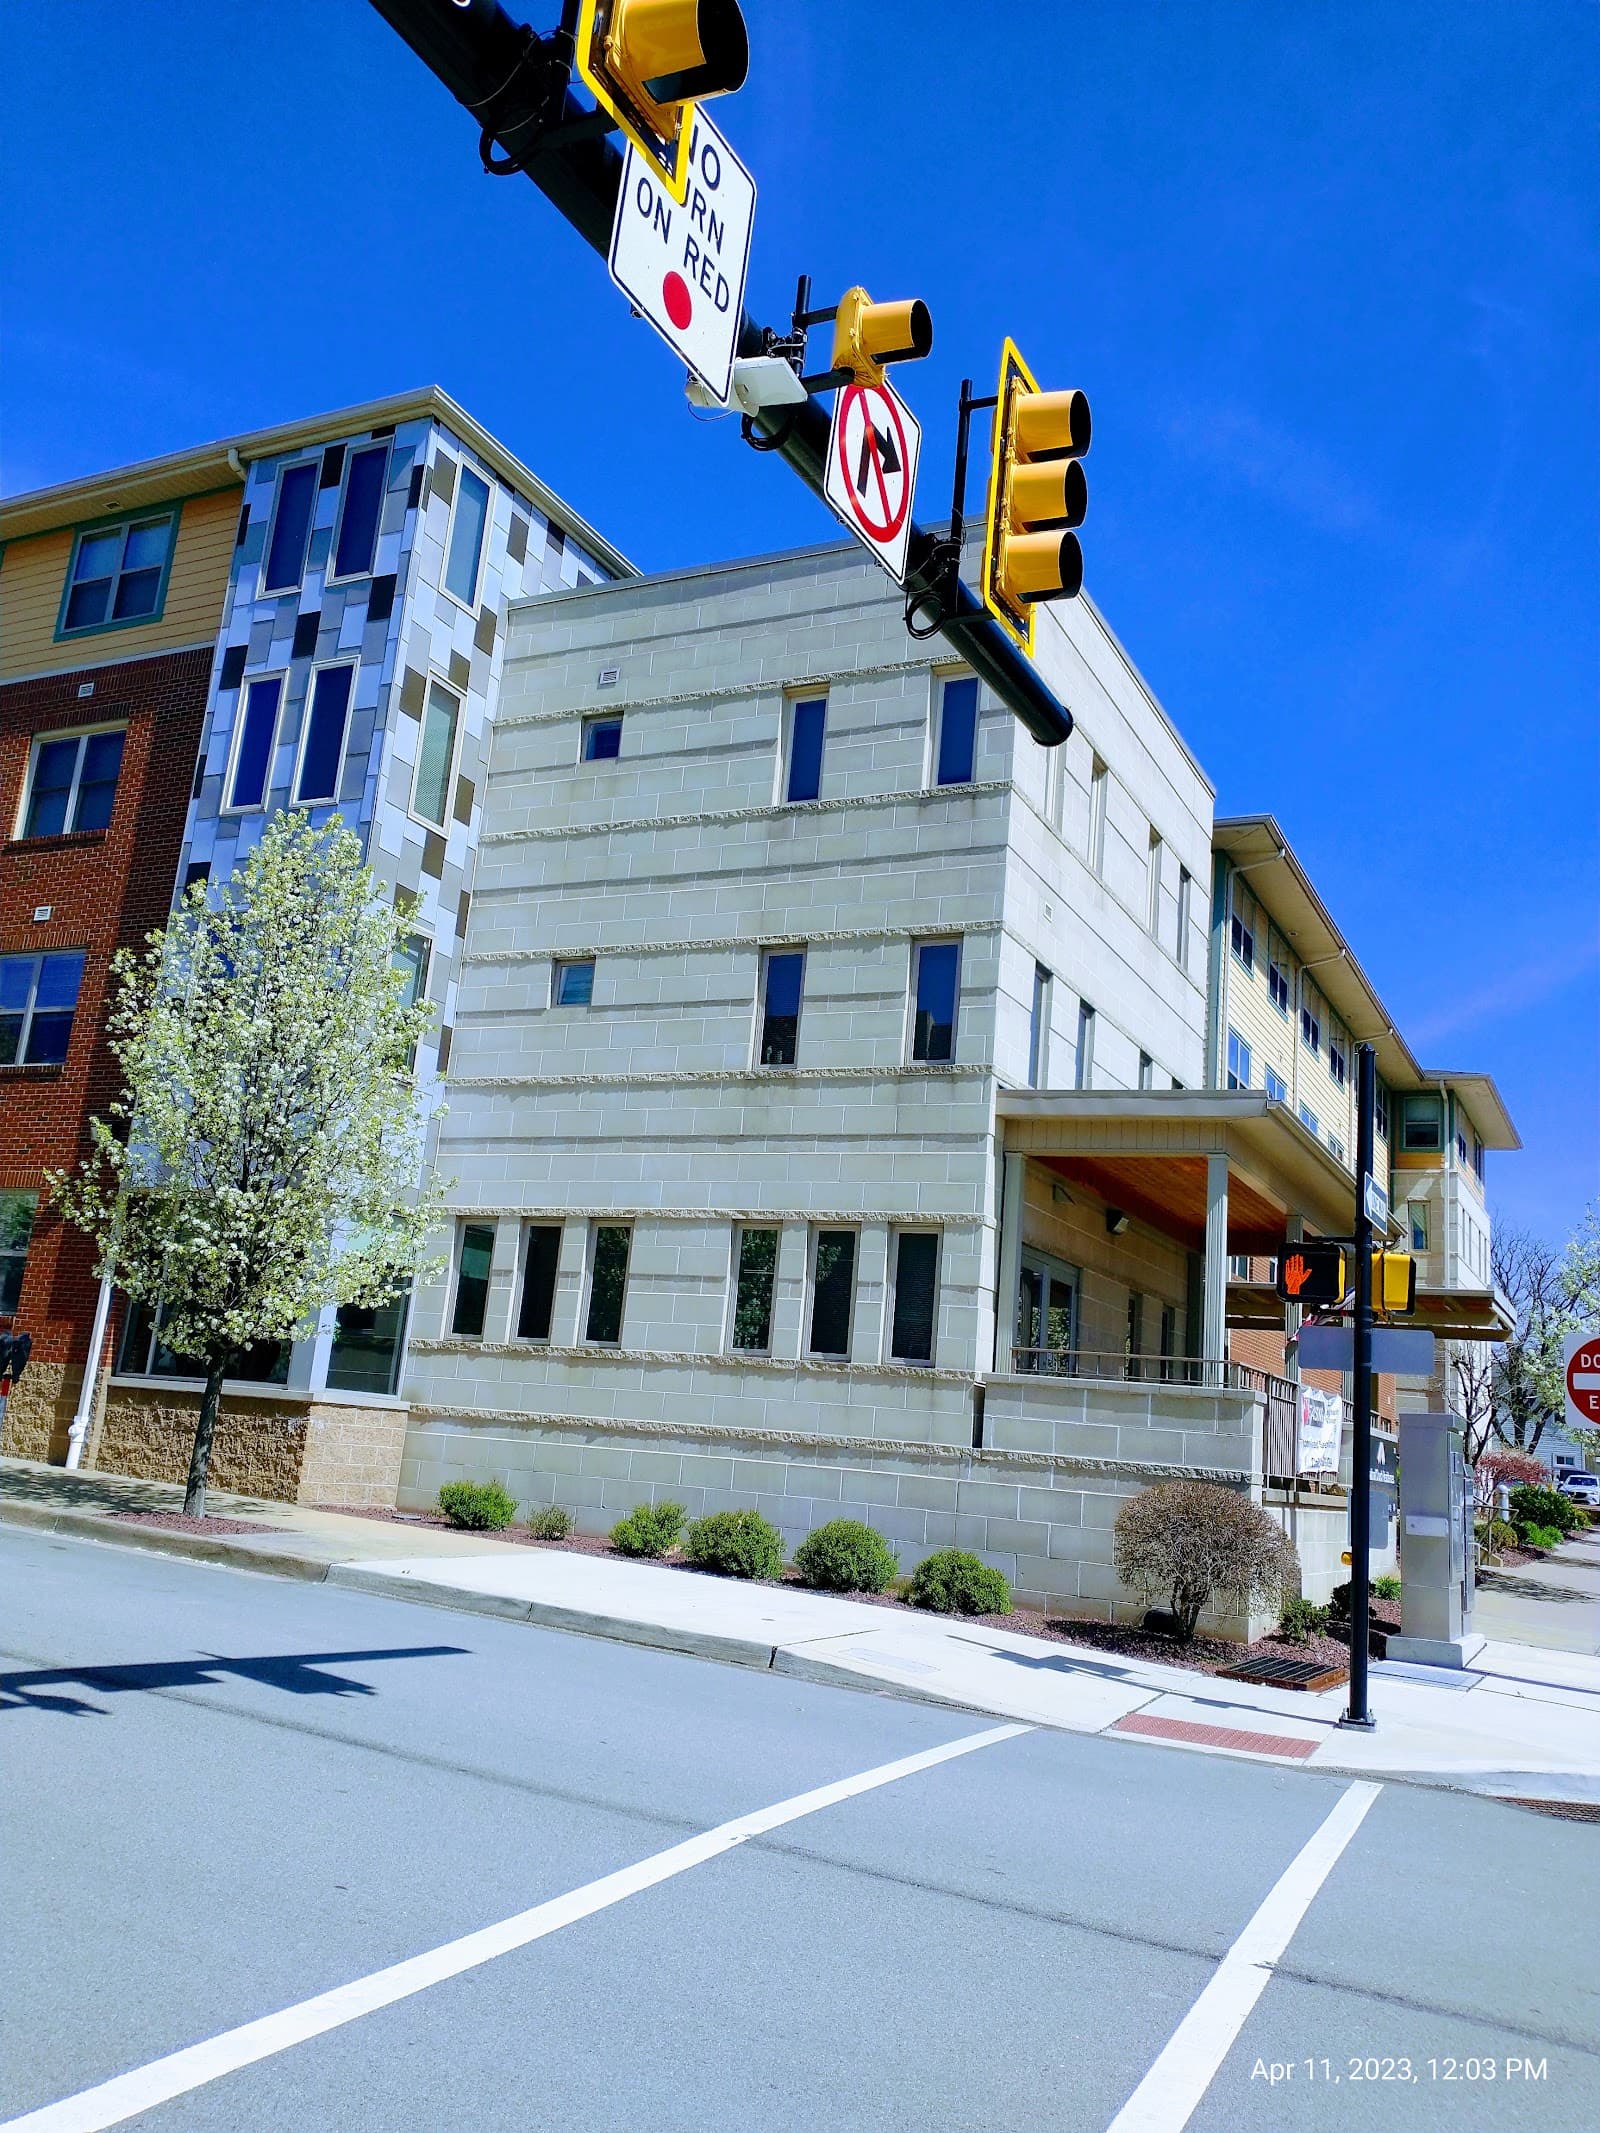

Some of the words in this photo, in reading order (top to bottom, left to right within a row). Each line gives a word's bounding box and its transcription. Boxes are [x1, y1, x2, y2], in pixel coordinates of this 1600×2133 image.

[636, 177, 672, 244] ON
[683, 233, 730, 313] RED
[681, 177, 724, 256] RN
